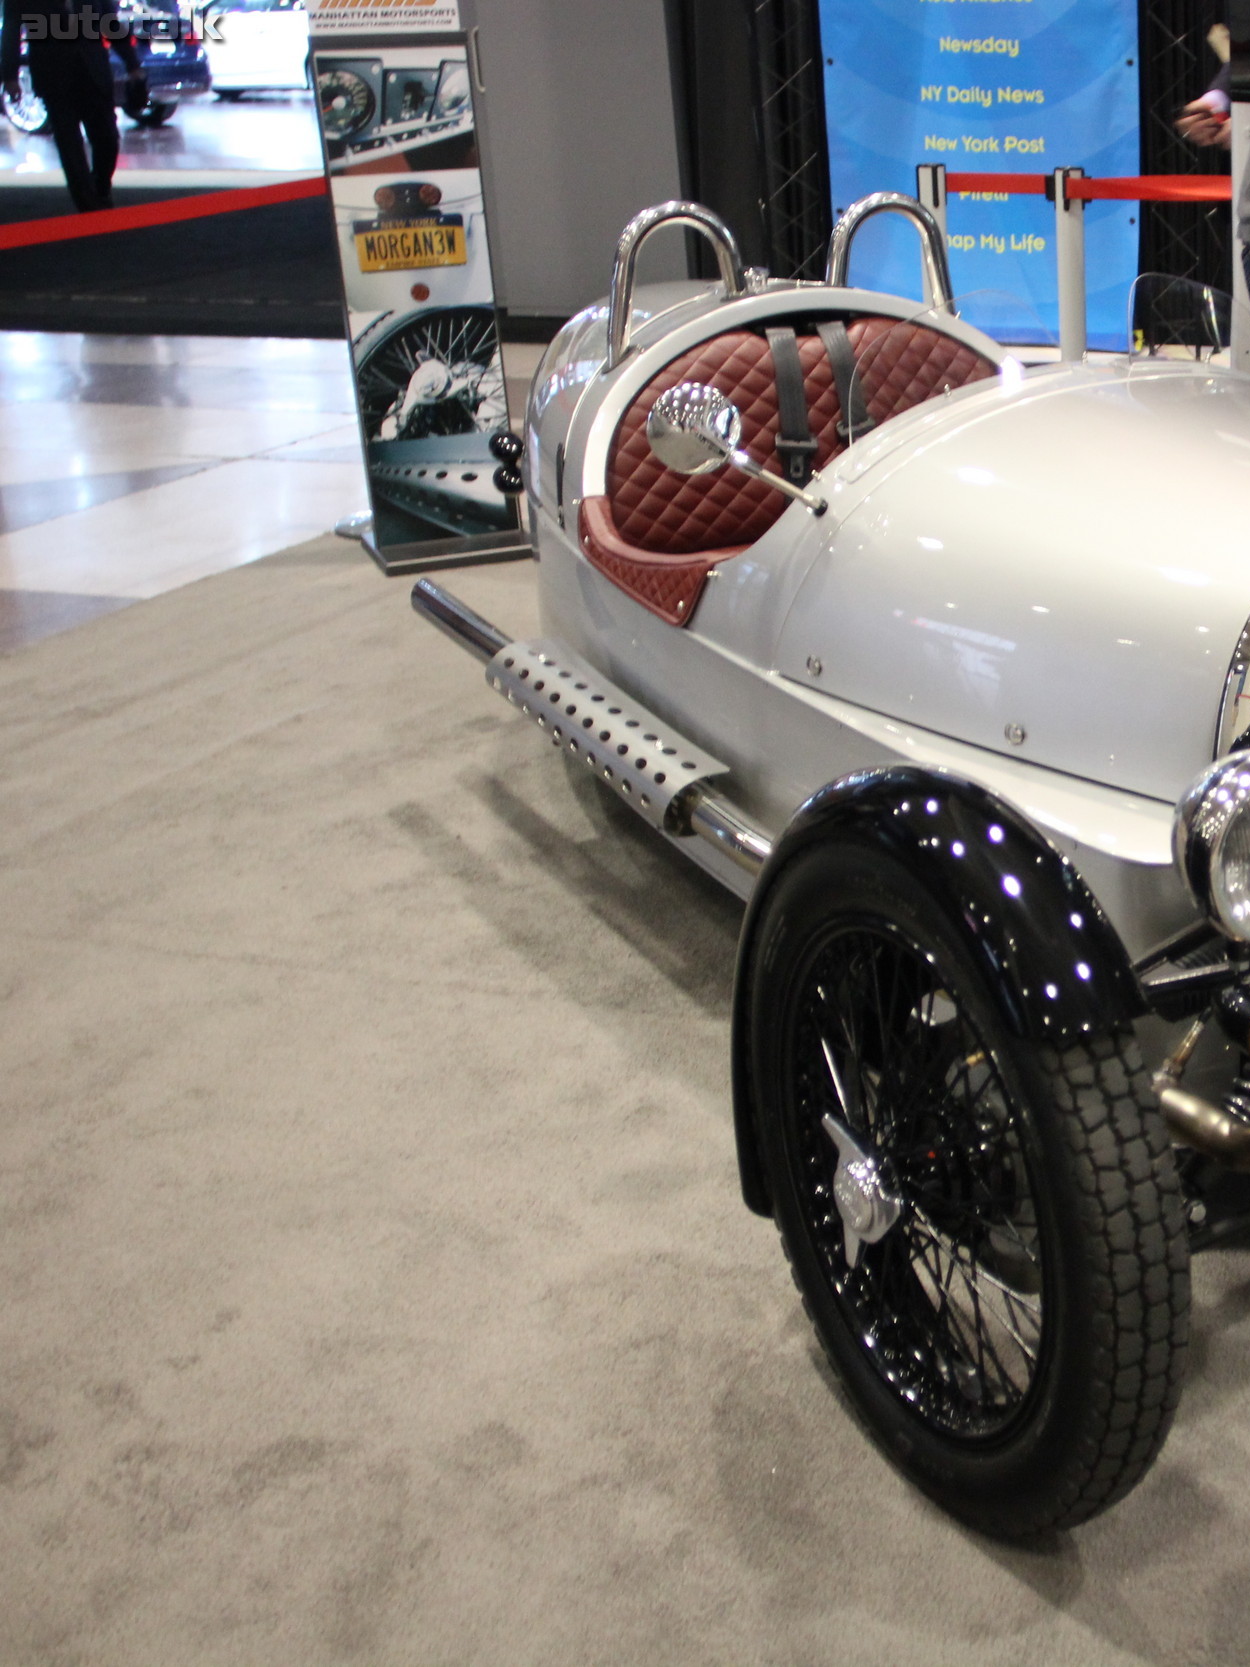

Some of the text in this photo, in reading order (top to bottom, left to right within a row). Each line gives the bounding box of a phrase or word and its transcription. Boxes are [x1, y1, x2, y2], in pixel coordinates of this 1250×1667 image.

[309, 8, 456, 20] MANHATTAN MOTORSPORTS
[940, 36, 1019, 58] Newsday
[921, 85, 1045, 108] NY Daily News
[924, 134, 1045, 153] New York Post
[365, 229, 456, 262] MORGAN3W
[980, 234, 1005, 254] My
[1011, 233, 1046, 254] Life
